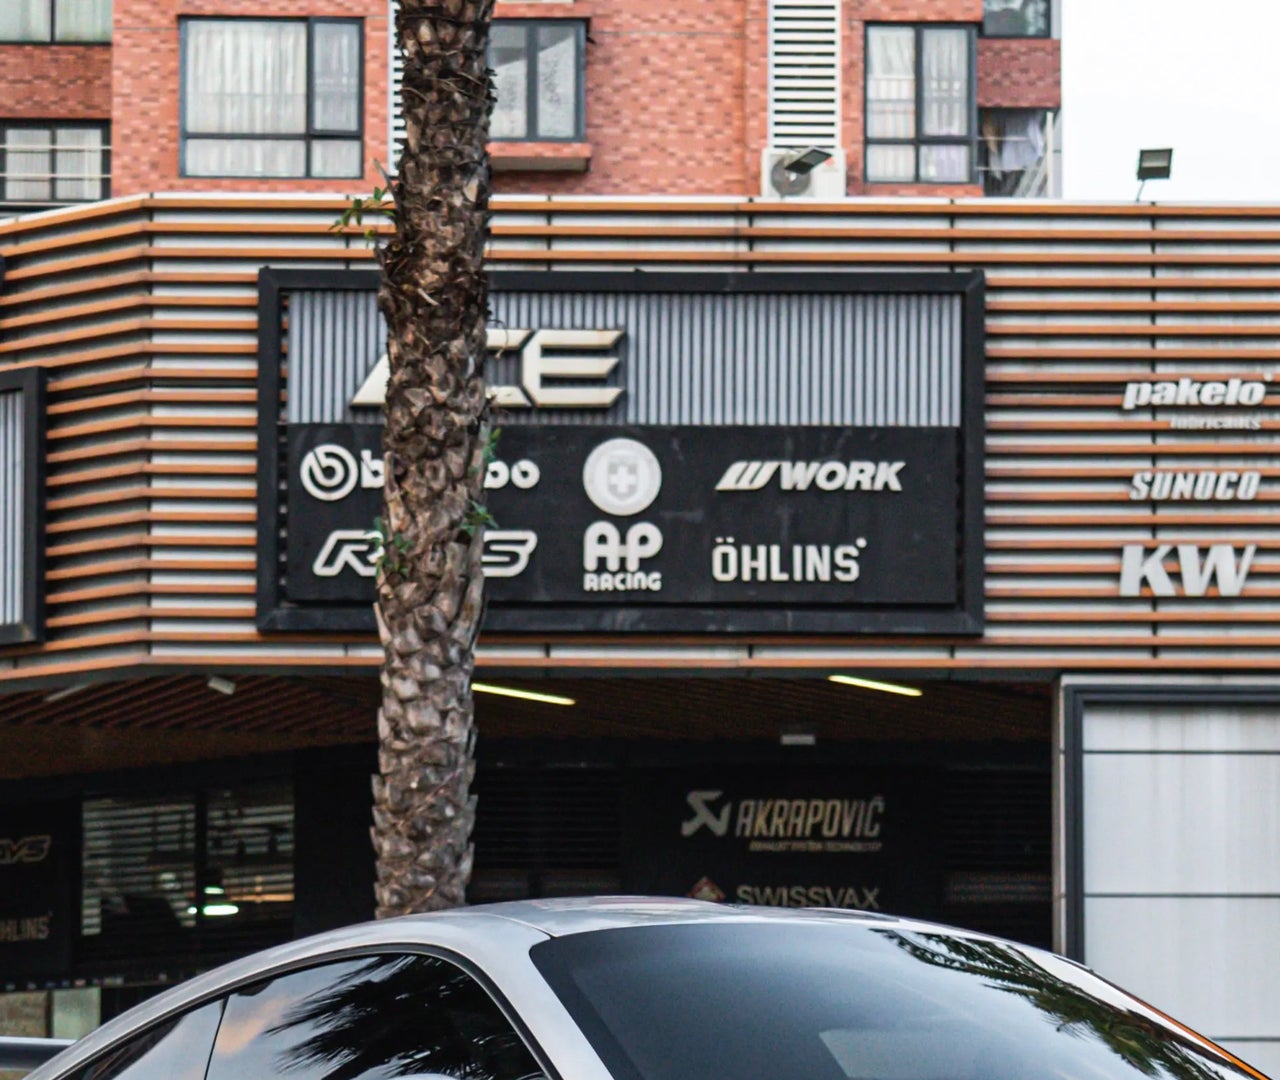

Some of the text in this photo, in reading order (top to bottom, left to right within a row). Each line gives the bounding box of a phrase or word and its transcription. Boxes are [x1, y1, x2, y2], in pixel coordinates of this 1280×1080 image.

[1122, 377, 1266, 411] pakelo
[778, 461, 906, 491] WORK
[1129, 471, 1262, 501] SUNOCO
[583, 521, 663, 572] AP
[712, 536, 860, 582] ÖHLINS
[1119, 543, 1257, 597] KW
[735, 884, 880, 909] SWISSVAX
